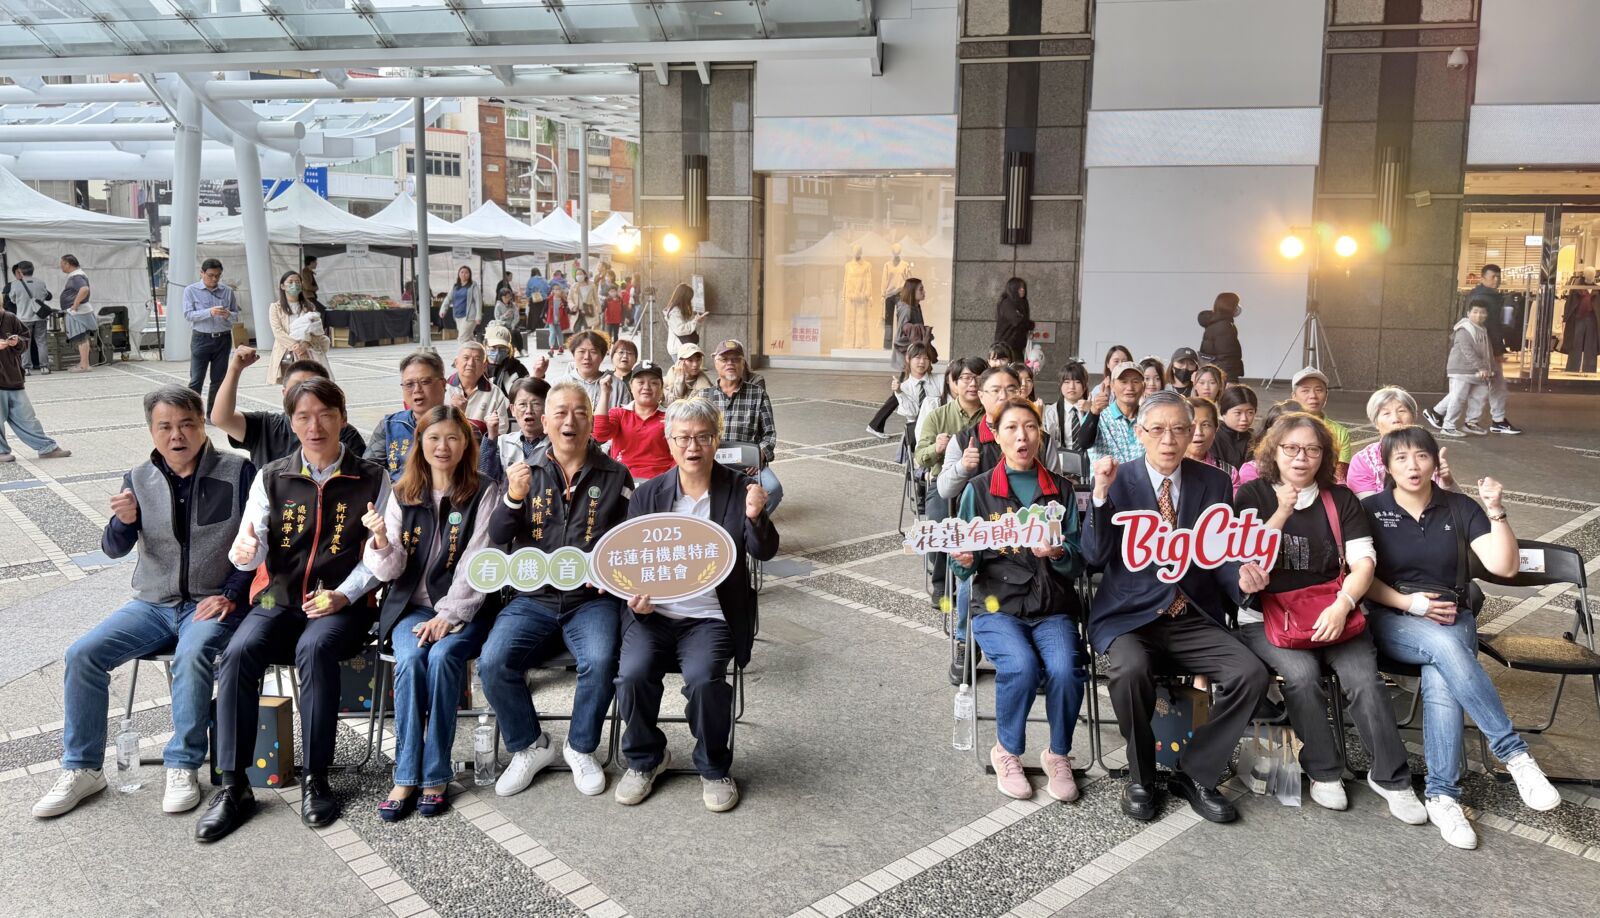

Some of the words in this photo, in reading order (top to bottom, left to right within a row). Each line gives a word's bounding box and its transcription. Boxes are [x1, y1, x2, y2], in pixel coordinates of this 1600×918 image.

[281, 508, 295, 548] 陳學立
[329, 502, 347, 554] 新竹市農會
[642, 526, 682, 543] 2025
[916, 517, 1044, 551] 花蓮有購力
[607, 542, 720, 567] 花蓮有機農特產
[641, 563, 689, 583] 展售會
